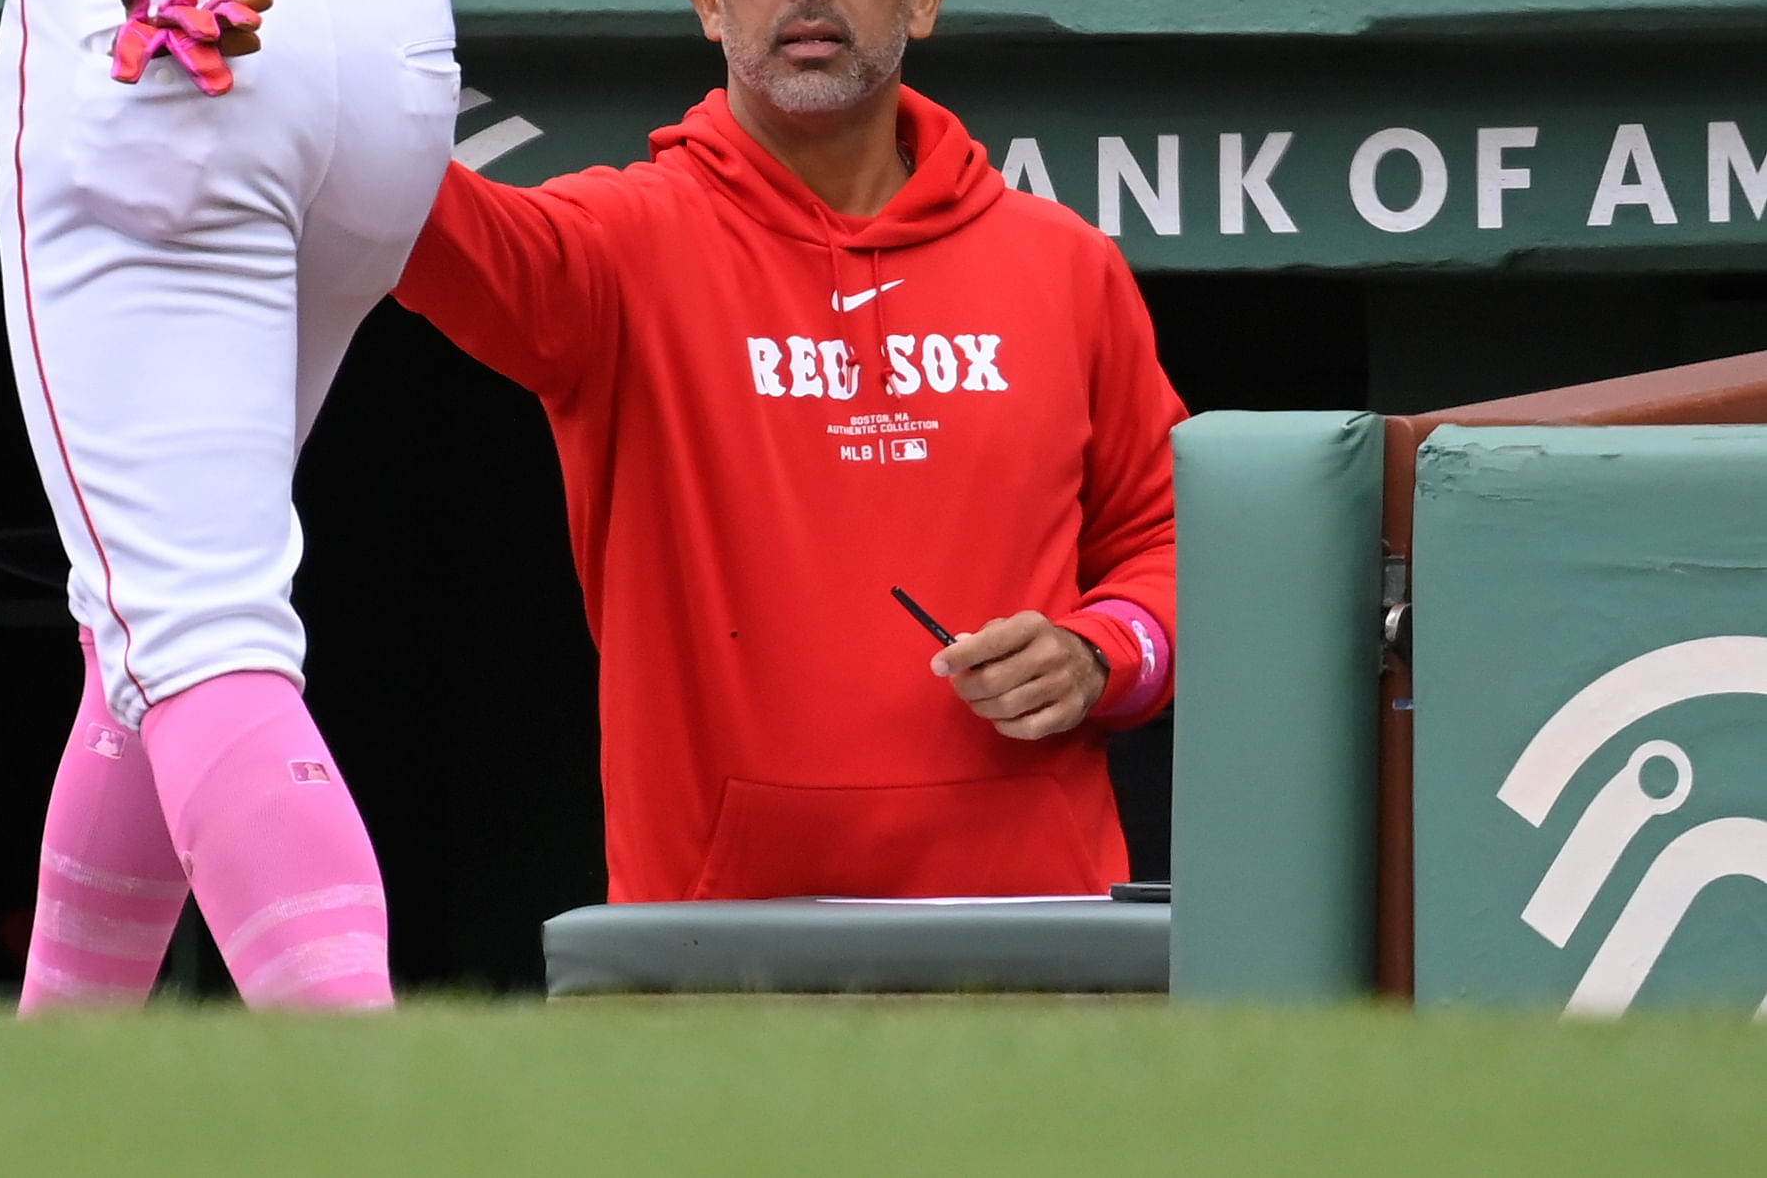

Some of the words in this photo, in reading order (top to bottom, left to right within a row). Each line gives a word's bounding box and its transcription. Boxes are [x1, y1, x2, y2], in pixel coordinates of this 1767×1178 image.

[1349, 126, 1539, 233] OF
[747, 335, 861, 400] RED
[884, 333, 1009, 396] SOX
[894, 412, 910, 423] MA
[826, 424, 878, 435] AUTHENTIC
[879, 420, 940, 433] COLLECTION
[840, 445, 873, 461] MLB
